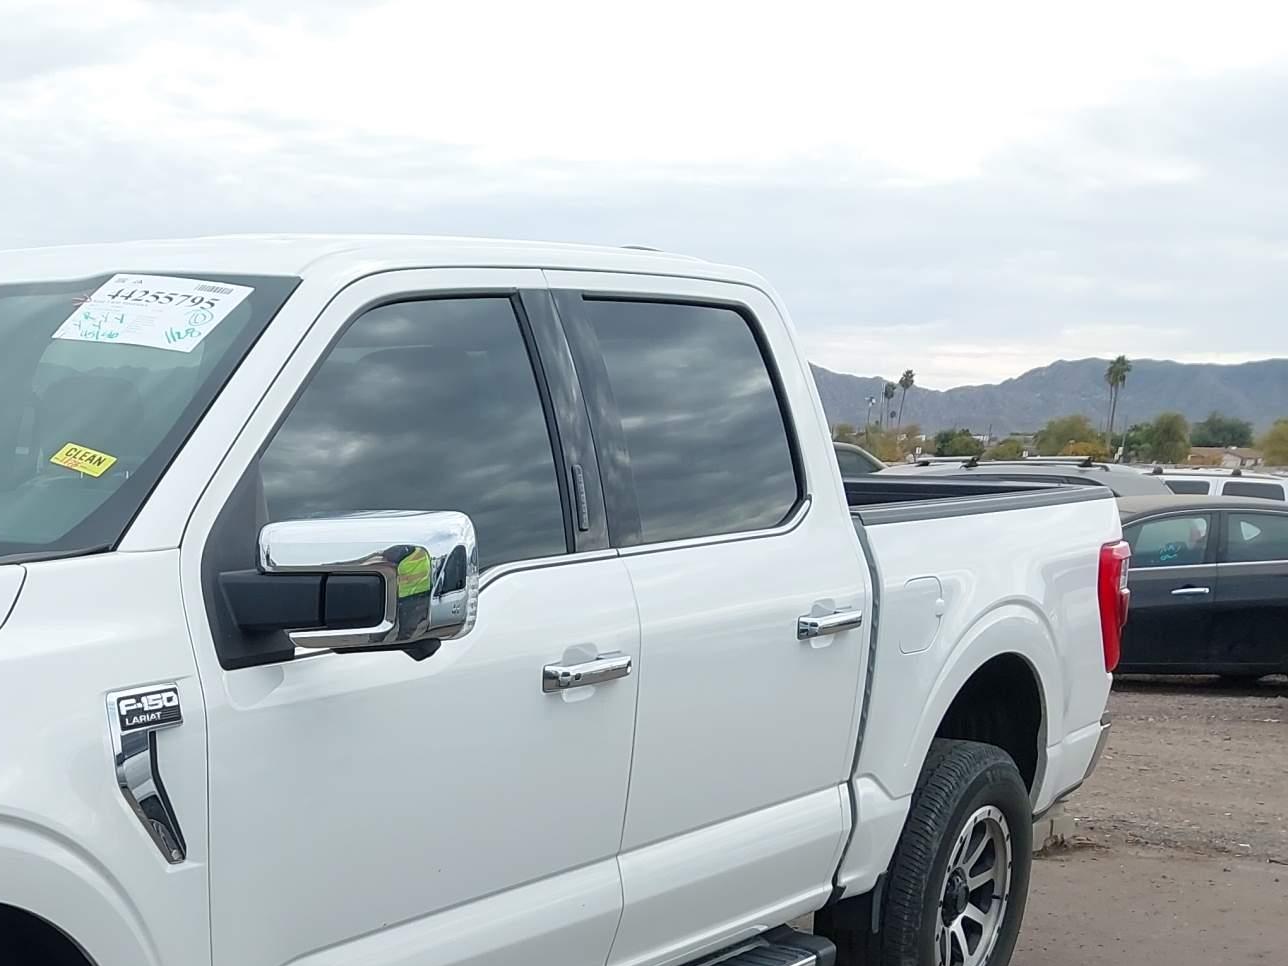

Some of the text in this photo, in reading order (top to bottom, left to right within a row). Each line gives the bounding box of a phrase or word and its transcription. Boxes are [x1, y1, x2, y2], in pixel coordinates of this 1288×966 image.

[107, 288, 220, 310] 44255795
[65, 447, 106, 467] CLEAN
[118, 691, 179, 716] F-150
[125, 711, 162, 726] LARIAT
